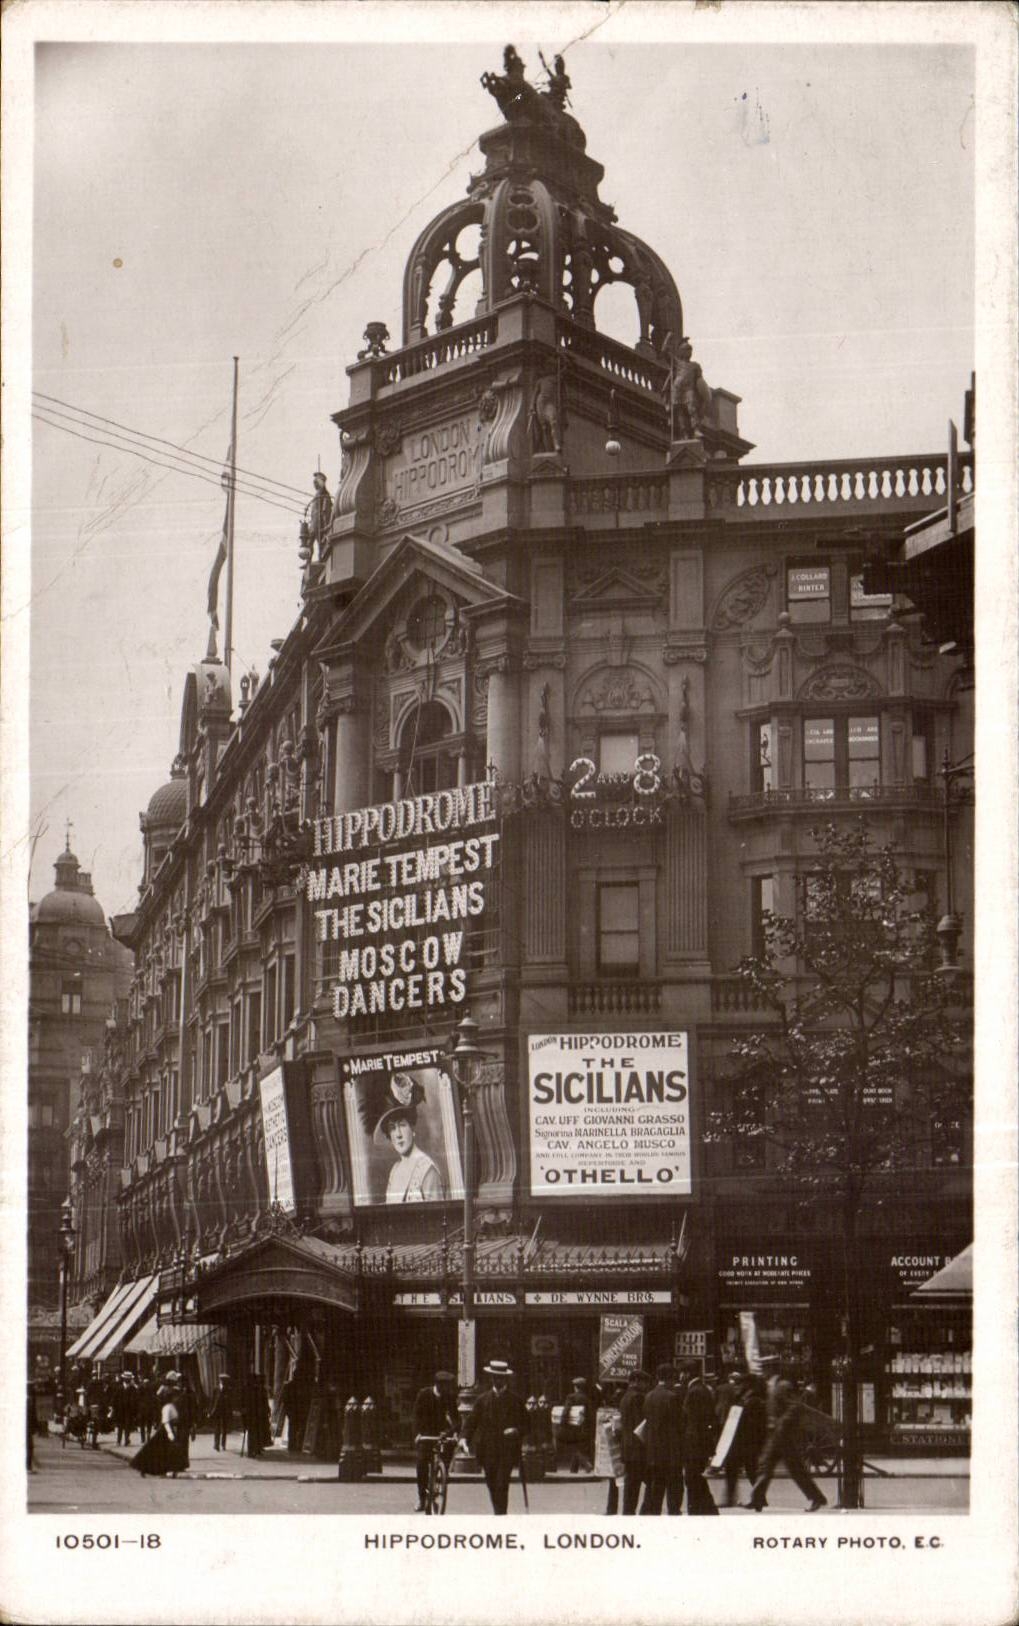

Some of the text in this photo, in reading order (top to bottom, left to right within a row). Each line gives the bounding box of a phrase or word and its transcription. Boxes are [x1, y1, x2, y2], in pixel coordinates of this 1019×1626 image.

[410, 419, 470, 462] LONDON
[569, 757, 597, 799] 2
[633, 753, 661, 795] 8
[313, 781, 496, 857] HIPPODROME
[307, 833, 500, 902] MARIE TEMPEST
[314, 881, 485, 941] THE SICILIANS
[339, 931, 463, 983] MOSCOW
[332, 969, 467, 1018] DANCERS
[560, 1034, 682, 1050] HIPPODROME
[350, 1049, 439, 1075] MARIE TEMPEST
[582, 1058, 635, 1068] THE
[533, 1070, 687, 1104] SICILIANS
[574, 1127, 627, 1137] MARINELLA
[631, 1127, 685, 1136] BRAGAGLIA
[584, 1114, 635, 1125] GIOVANNI
[638, 1114, 685, 1125] GRASSO
[577, 1140, 629, 1150] ANGELO
[634, 1139, 676, 1149] MUSCO
[732, 1256, 798, 1267] PRINTING
[891, 1256, 940, 1267] ACCOUNT
[396, 1294, 430, 1304] THE
